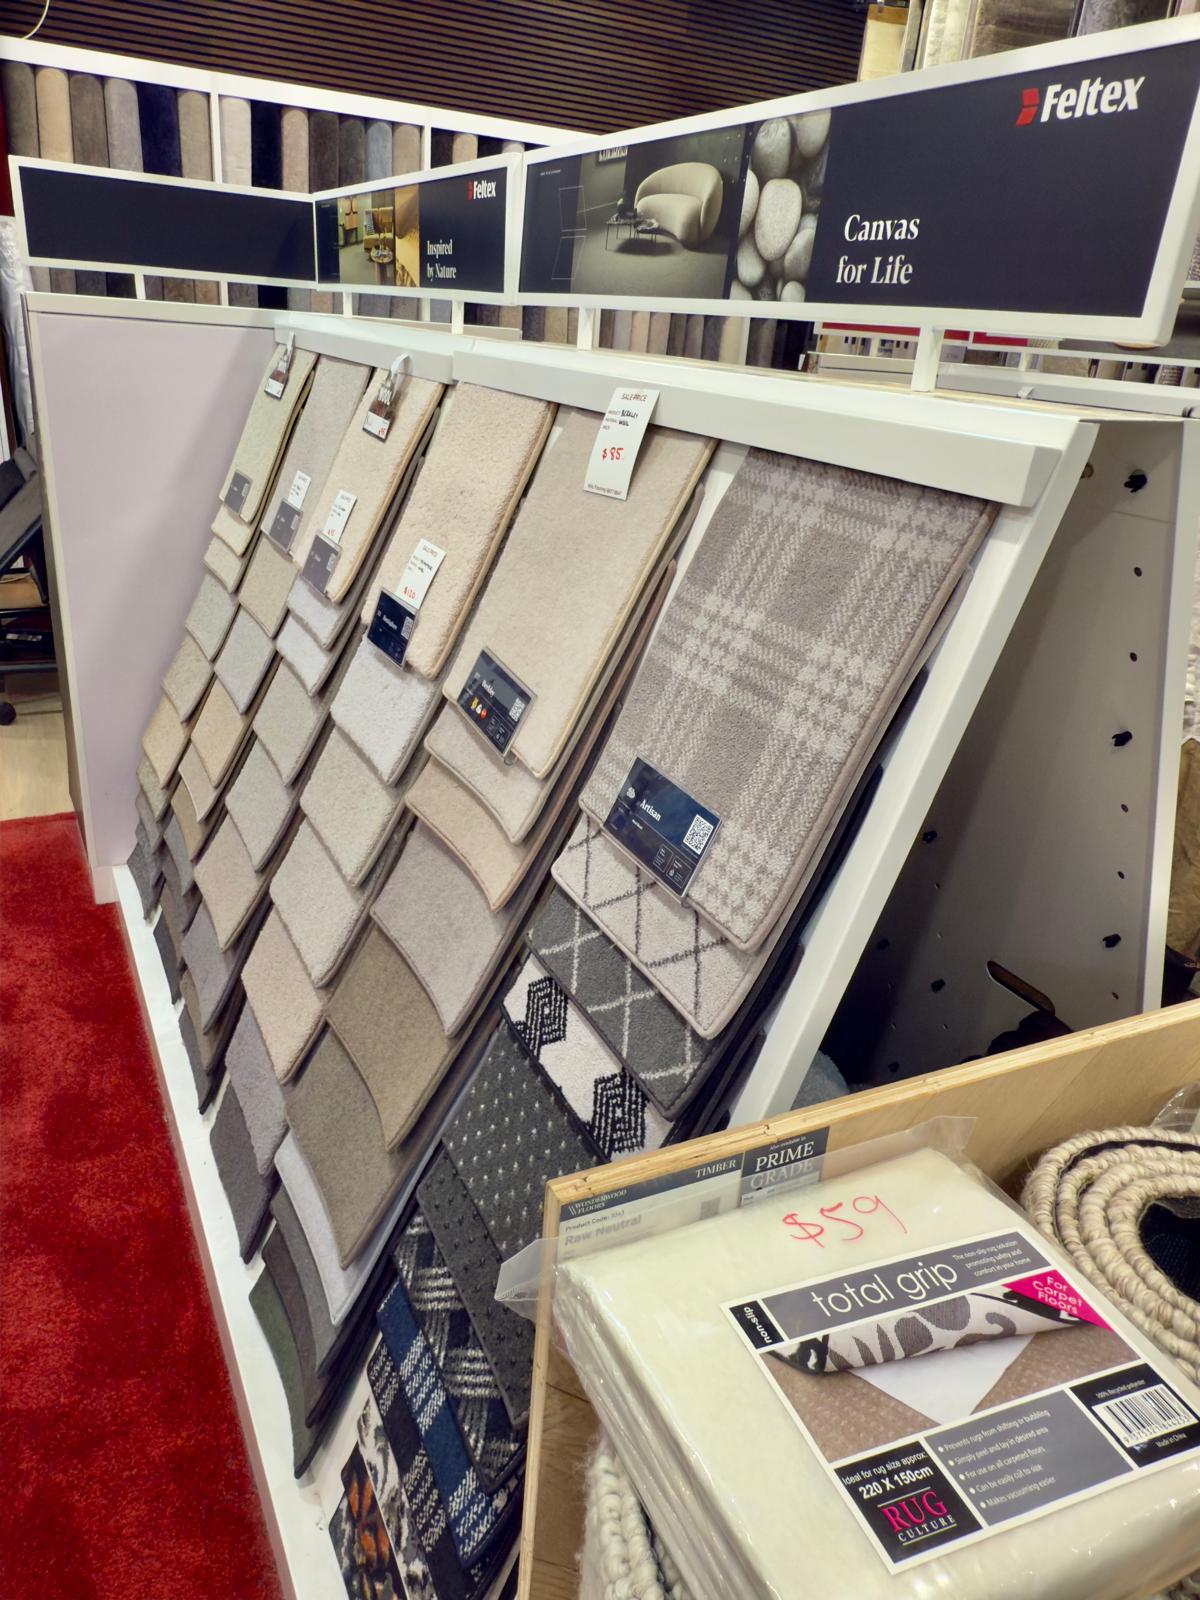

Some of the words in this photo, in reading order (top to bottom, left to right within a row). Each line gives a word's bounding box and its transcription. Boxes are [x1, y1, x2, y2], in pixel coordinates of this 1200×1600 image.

[1040, 76, 1146, 122] Feltex
[473, 179, 497, 200] Feltex
[844, 214, 920, 242] Canvas
[427, 239, 453, 258] Inspired
[427, 265, 434, 282] by
[435, 268, 457, 280] Nature
[835, 255, 866, 284] for
[870, 254, 913, 285] Life
[640, 800, 662, 822] Artisan
[695, 1159, 736, 1178] TIMBER
[754, 1141, 814, 1172] PRIME
[750, 1159, 814, 1189] GRADE
[578, 1202, 606, 1215] FLOORS
[782, 1194, 908, 1248] $59
[565, 1231, 592, 1246] Raw
[596, 1215, 642, 1236] Neutral
[566, 1221, 590, 1232] Product
[810, 1273, 895, 1317] total
[897, 1261, 958, 1301] grip
[1033, 1281, 1082, 1308] Carpet
[1047, 1276, 1068, 1292] For
[1038, 1291, 1078, 1315] Floors
[743, 1306, 772, 1344] non-slip
[944, 1438, 970, 1451] Prevents
[970, 1432, 984, 1443] rugs
[982, 1426, 998, 1438] from
[996, 1420, 1019, 1432] shifting
[1023, 1408, 1051, 1423] bubbling
[954, 1453, 976, 1465] Simply
[976, 1448, 988, 1459] peel
[988, 1443, 1000, 1453] and
[999, 1439, 1010, 1449] lay
[1015, 1431, 1037, 1443] desired
[1035, 1426, 1049, 1436] area
[842, 1471, 862, 1486] Ideal
[861, 1468, 872, 1480] for
[872, 1465, 886, 1476] rug
[886, 1460, 900, 1472] size
[901, 1451, 928, 1466] approx:
[964, 1468, 976, 1479] For
[976, 1466, 988, 1475] use
[987, 1462, 996, 1472] on
[1002, 1450, 1030, 1466] carpeted
[858, 1481, 883, 1500] 220
[881, 1477, 896, 1491] X
[894, 1466, 934, 1486] 150cm
[975, 1483, 990, 1493] Can
[988, 1480, 998, 1489] be
[997, 1474, 1014, 1487] easily
[1014, 1469, 1025, 1480] cut
[881, 1490, 948, 1534] RUG
[985, 1495, 1008, 1507] Makes
[898, 1514, 956, 1542] CULTURE
